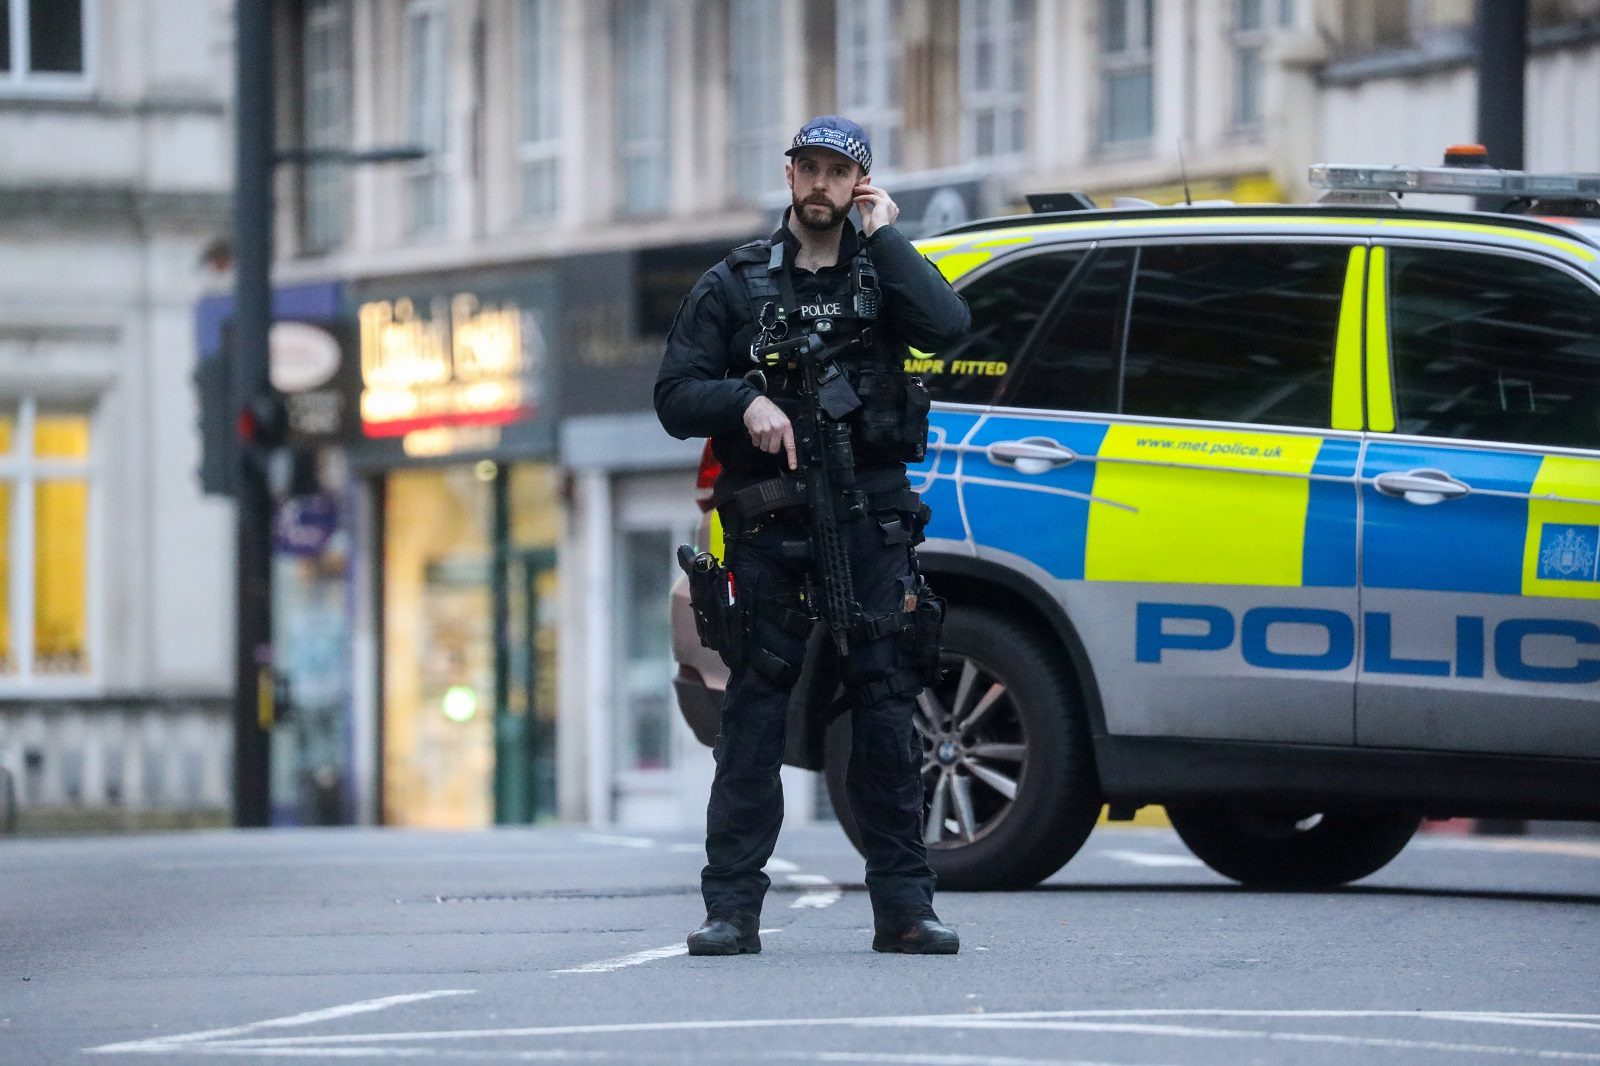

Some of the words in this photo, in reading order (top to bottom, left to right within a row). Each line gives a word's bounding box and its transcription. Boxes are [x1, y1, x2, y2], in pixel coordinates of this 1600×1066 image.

[824, 138, 845, 147] OFFICER
[801, 303, 842, 316] POLICE
[951, 361, 1008, 376] FITTED
[1136, 437, 1282, 459] www.met.police.uk
